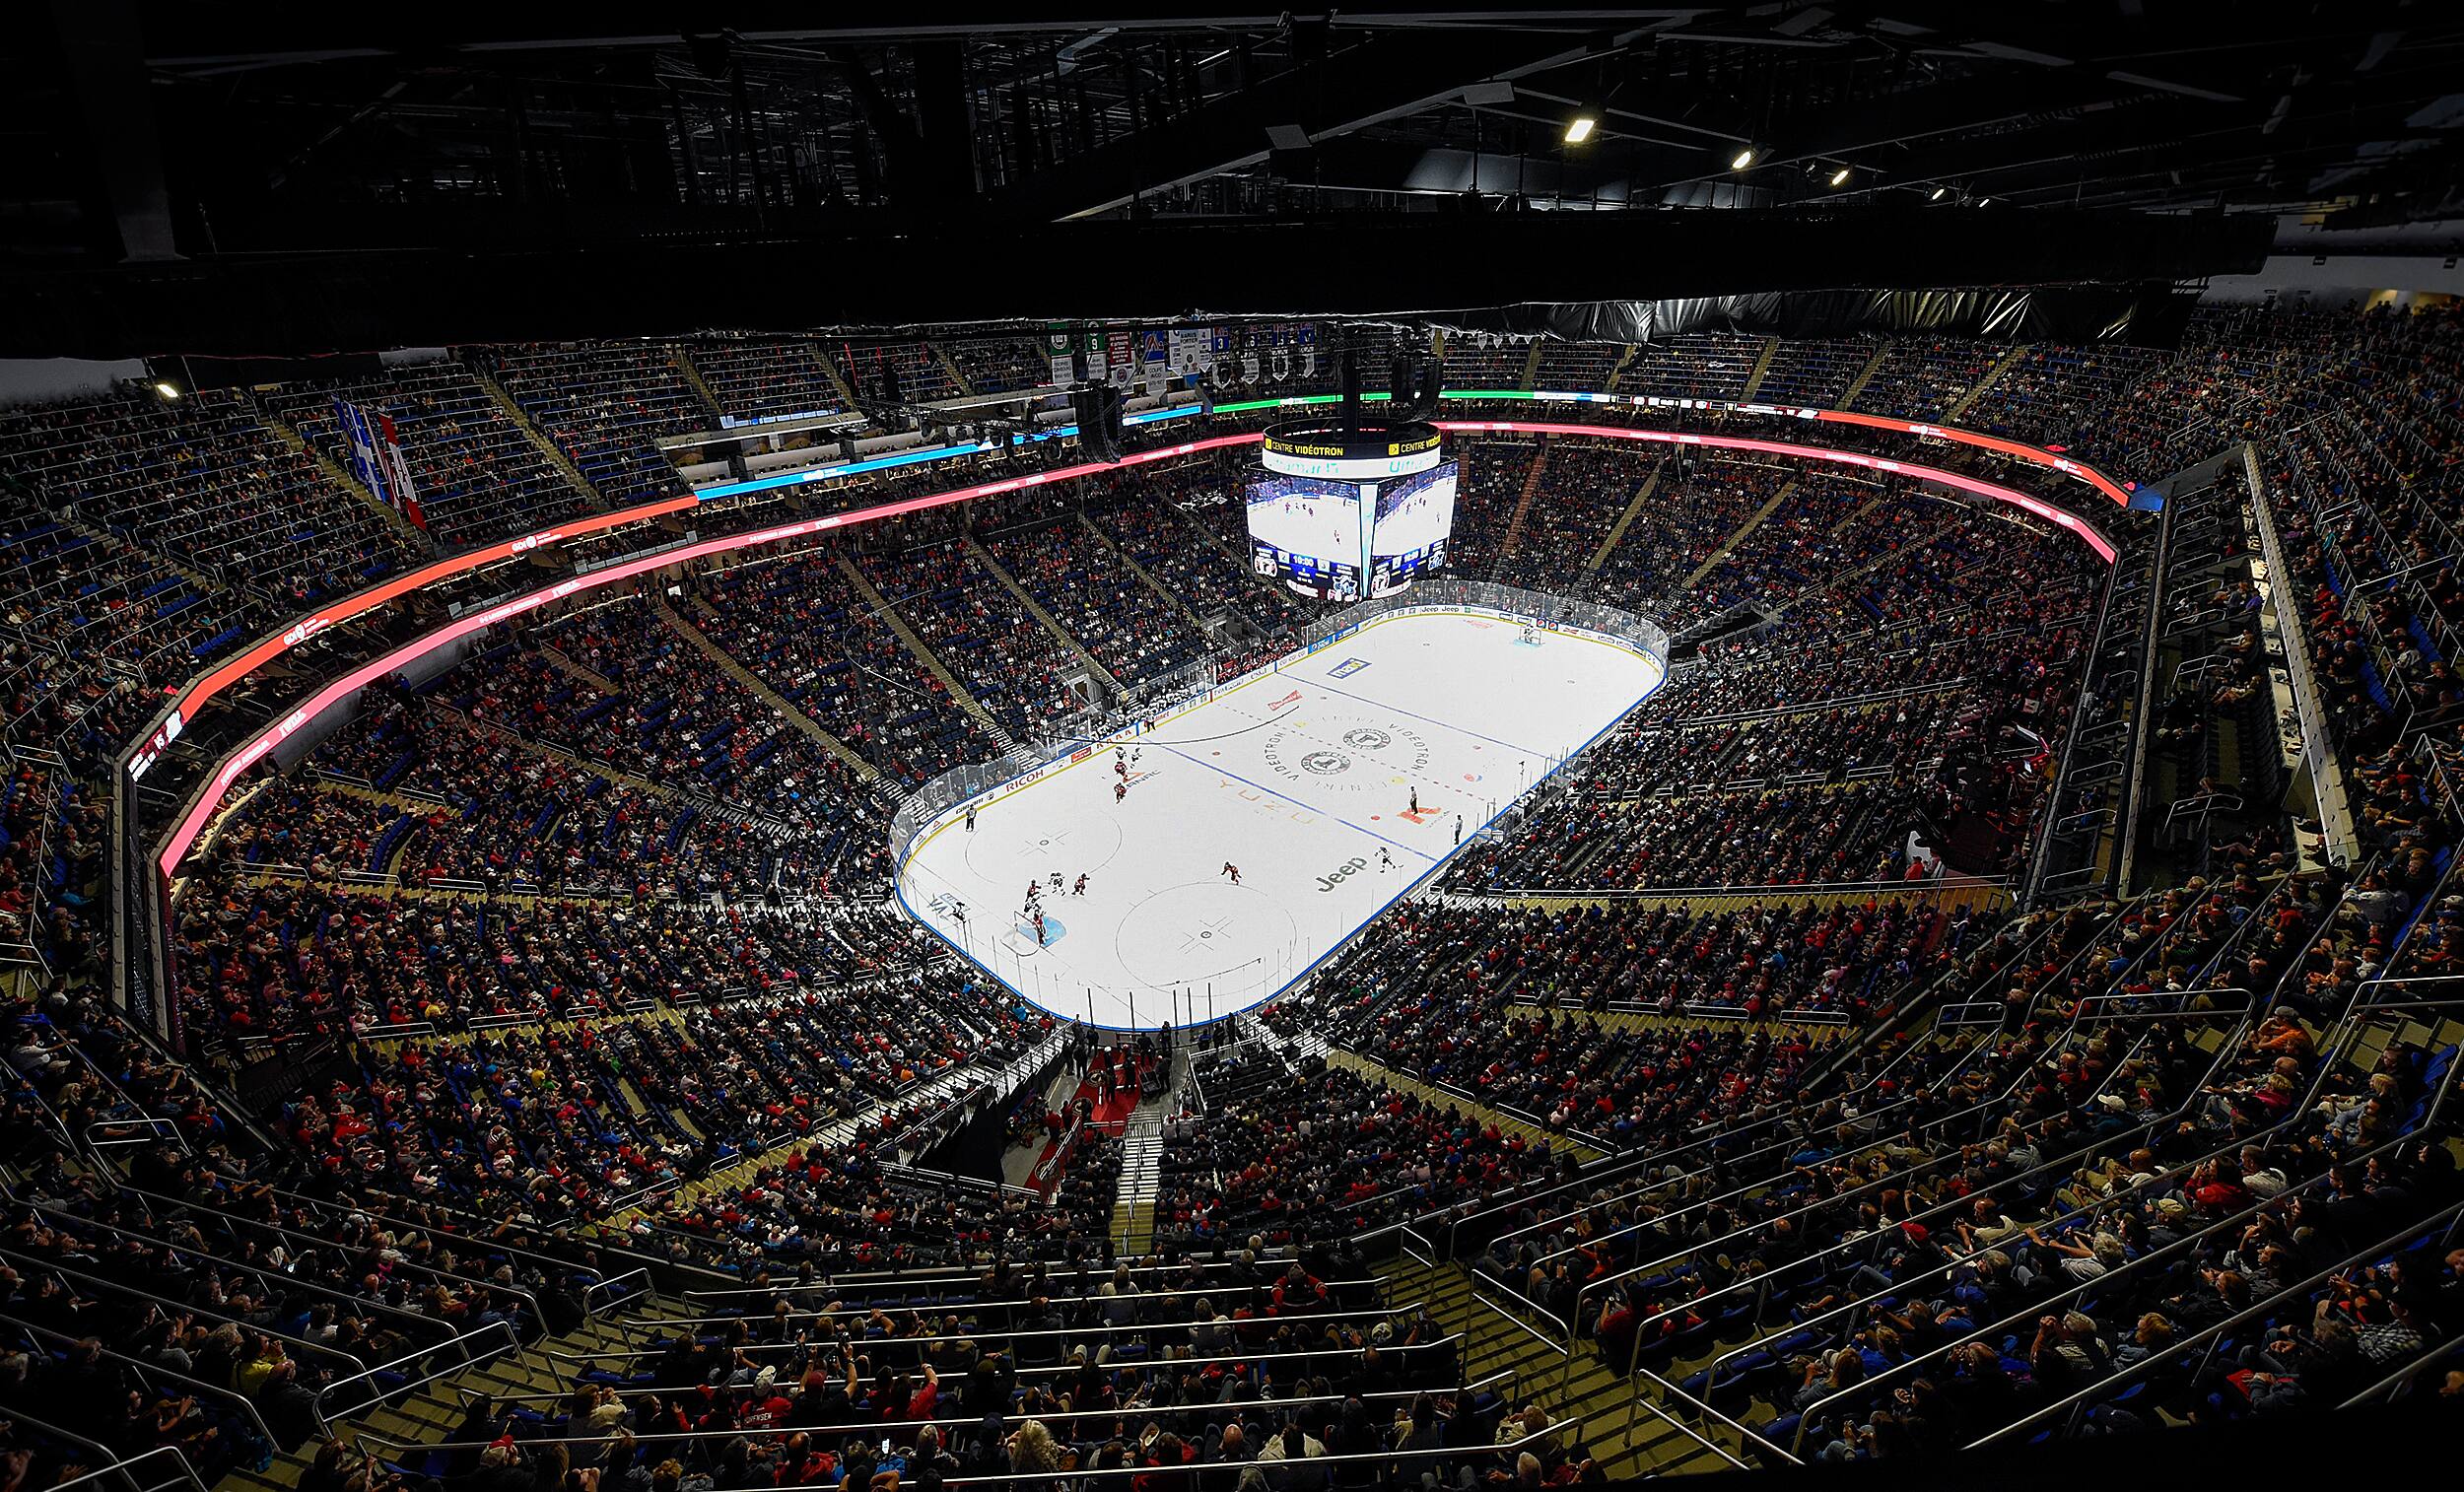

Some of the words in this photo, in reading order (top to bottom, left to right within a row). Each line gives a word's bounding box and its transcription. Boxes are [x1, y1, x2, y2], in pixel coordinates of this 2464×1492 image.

[1218, 338, 1223, 349] 3
[1272, 441, 1293, 453] CENTRE
[1295, 444, 1343, 456] VIDÉOTRON
[1402, 441, 1425, 452] CENTRE
[1005, 769, 1044, 792] RICOH
[1315, 856, 1368, 893] Jeep
